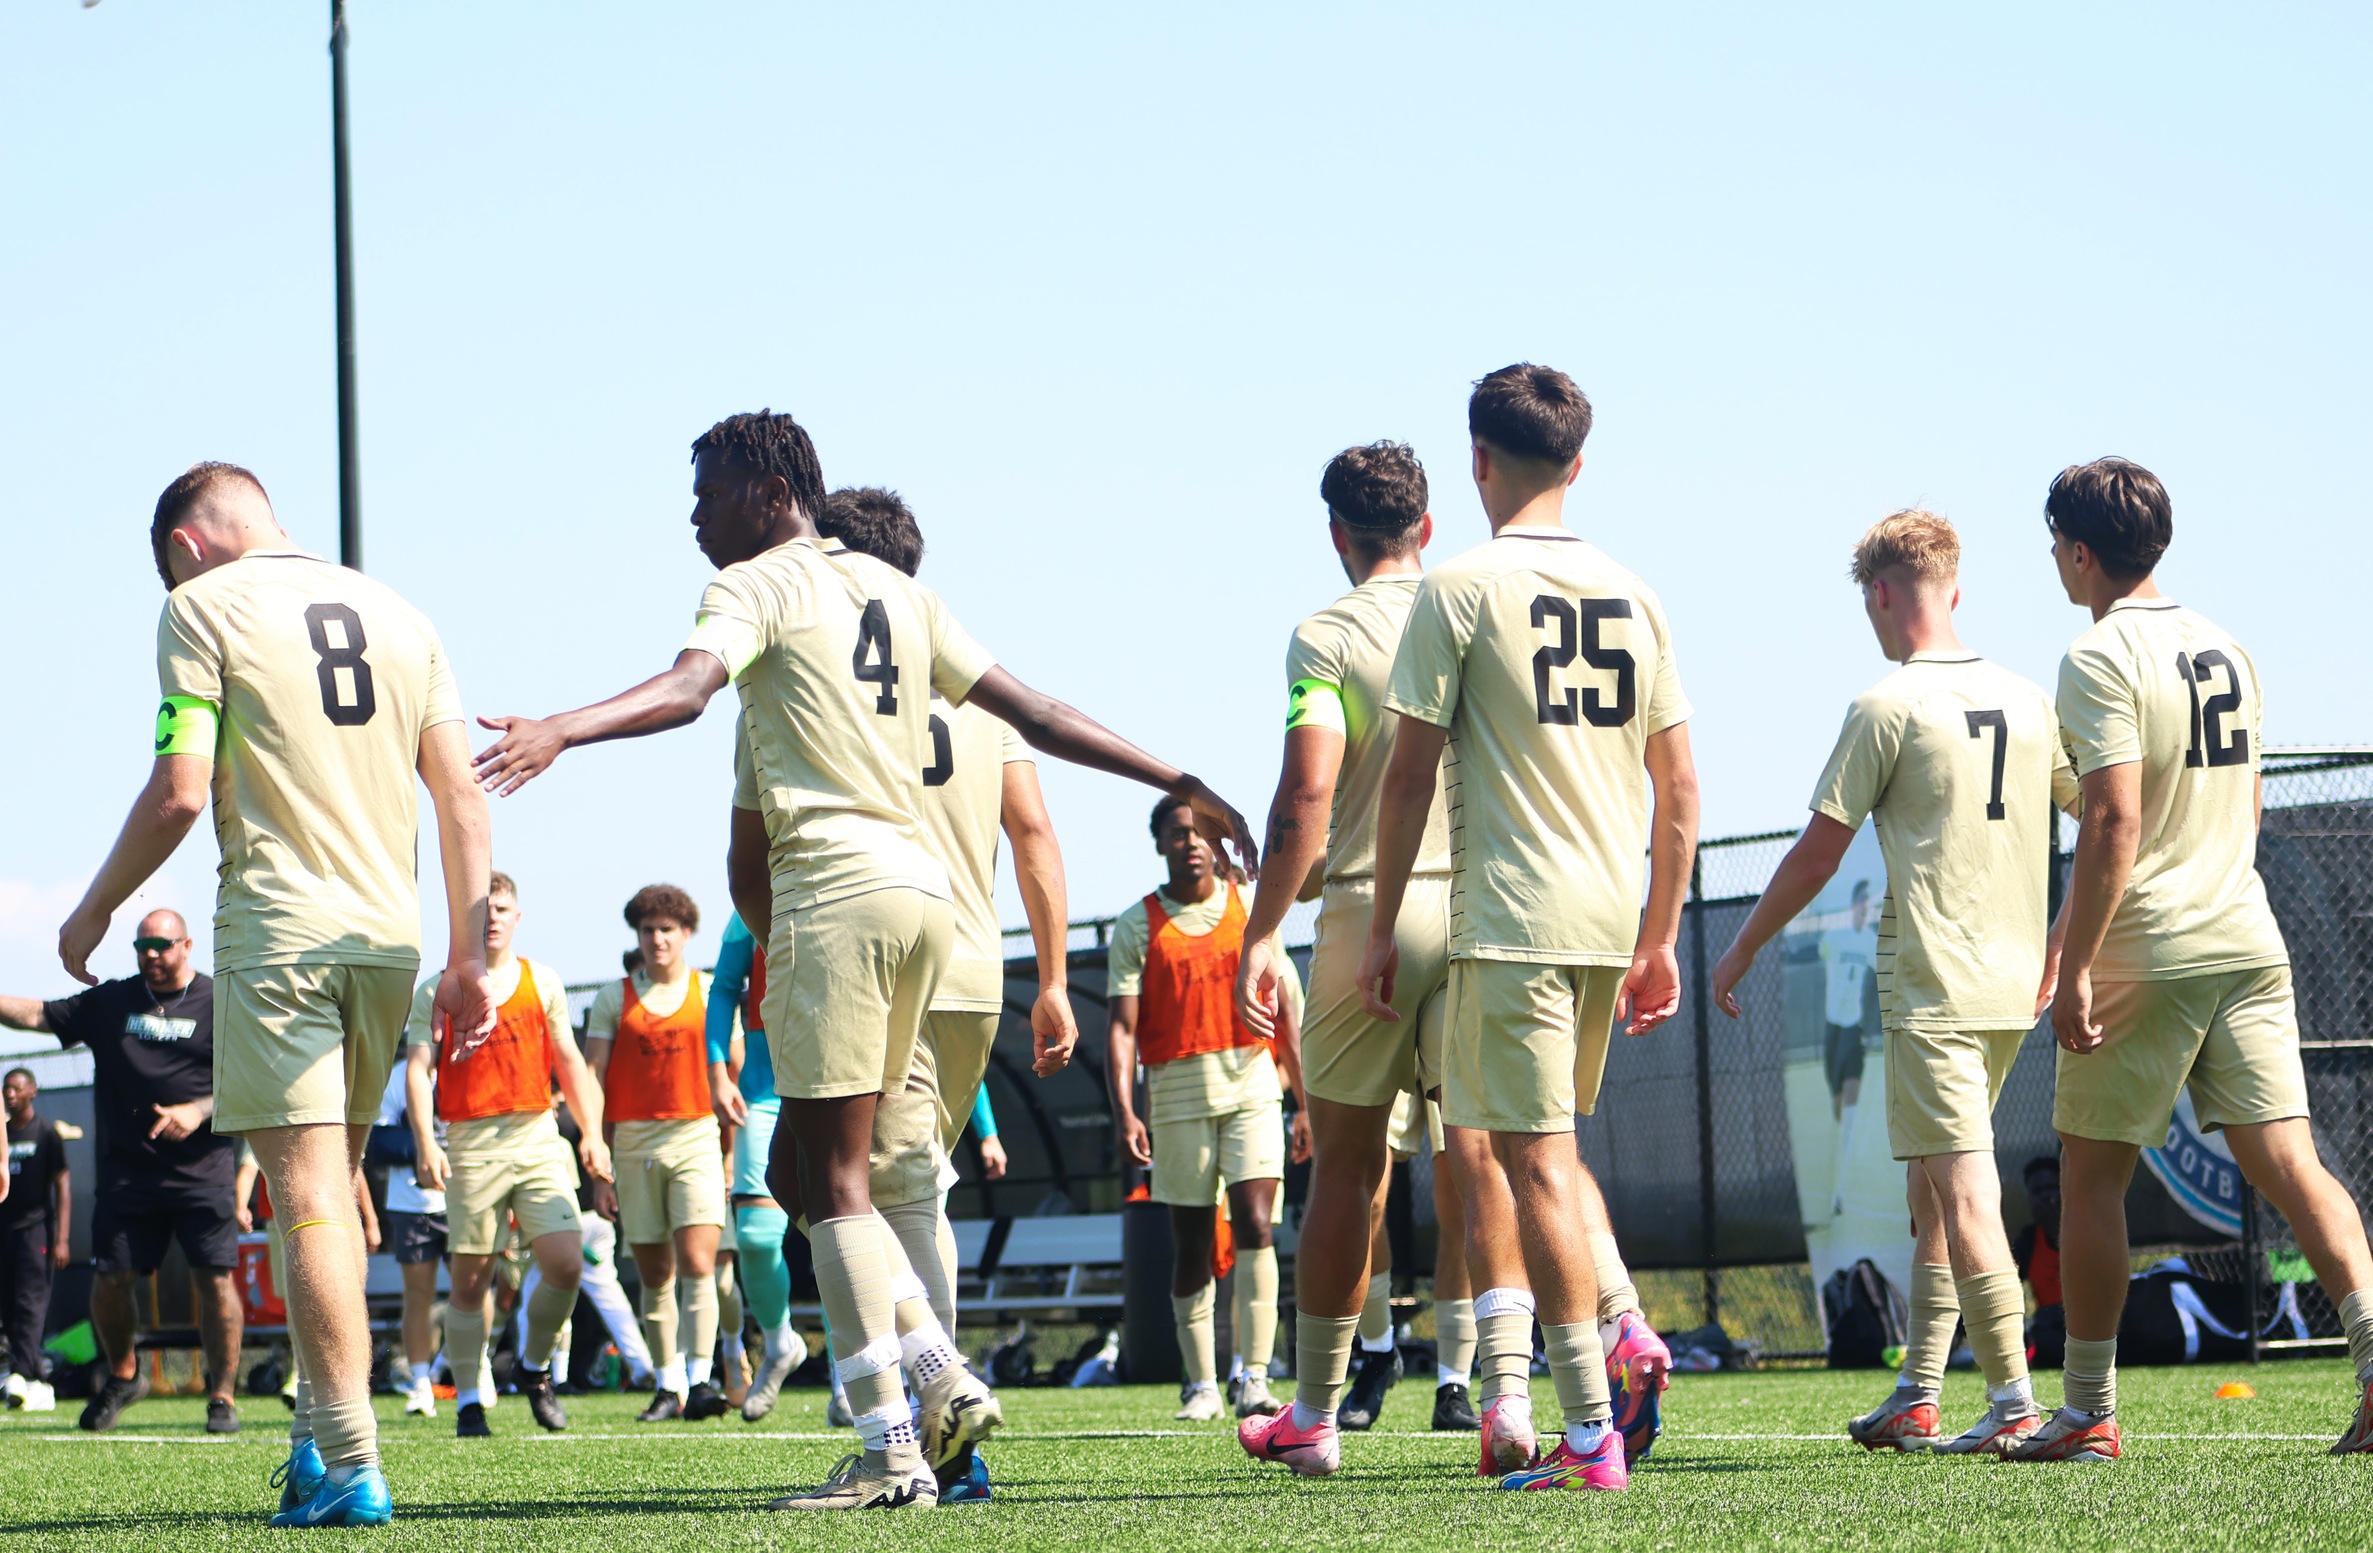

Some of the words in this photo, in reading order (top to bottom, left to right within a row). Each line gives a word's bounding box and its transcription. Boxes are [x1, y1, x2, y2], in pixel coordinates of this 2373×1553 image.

[304, 603, 376, 726] 8
[853, 598, 899, 716] 4
[1530, 595, 1635, 727] 25
[2176, 649, 2249, 768] 12
[155, 702, 177, 751] C
[1965, 710, 2008, 820] 7
[2166, 1124, 2233, 1199] OOTB
